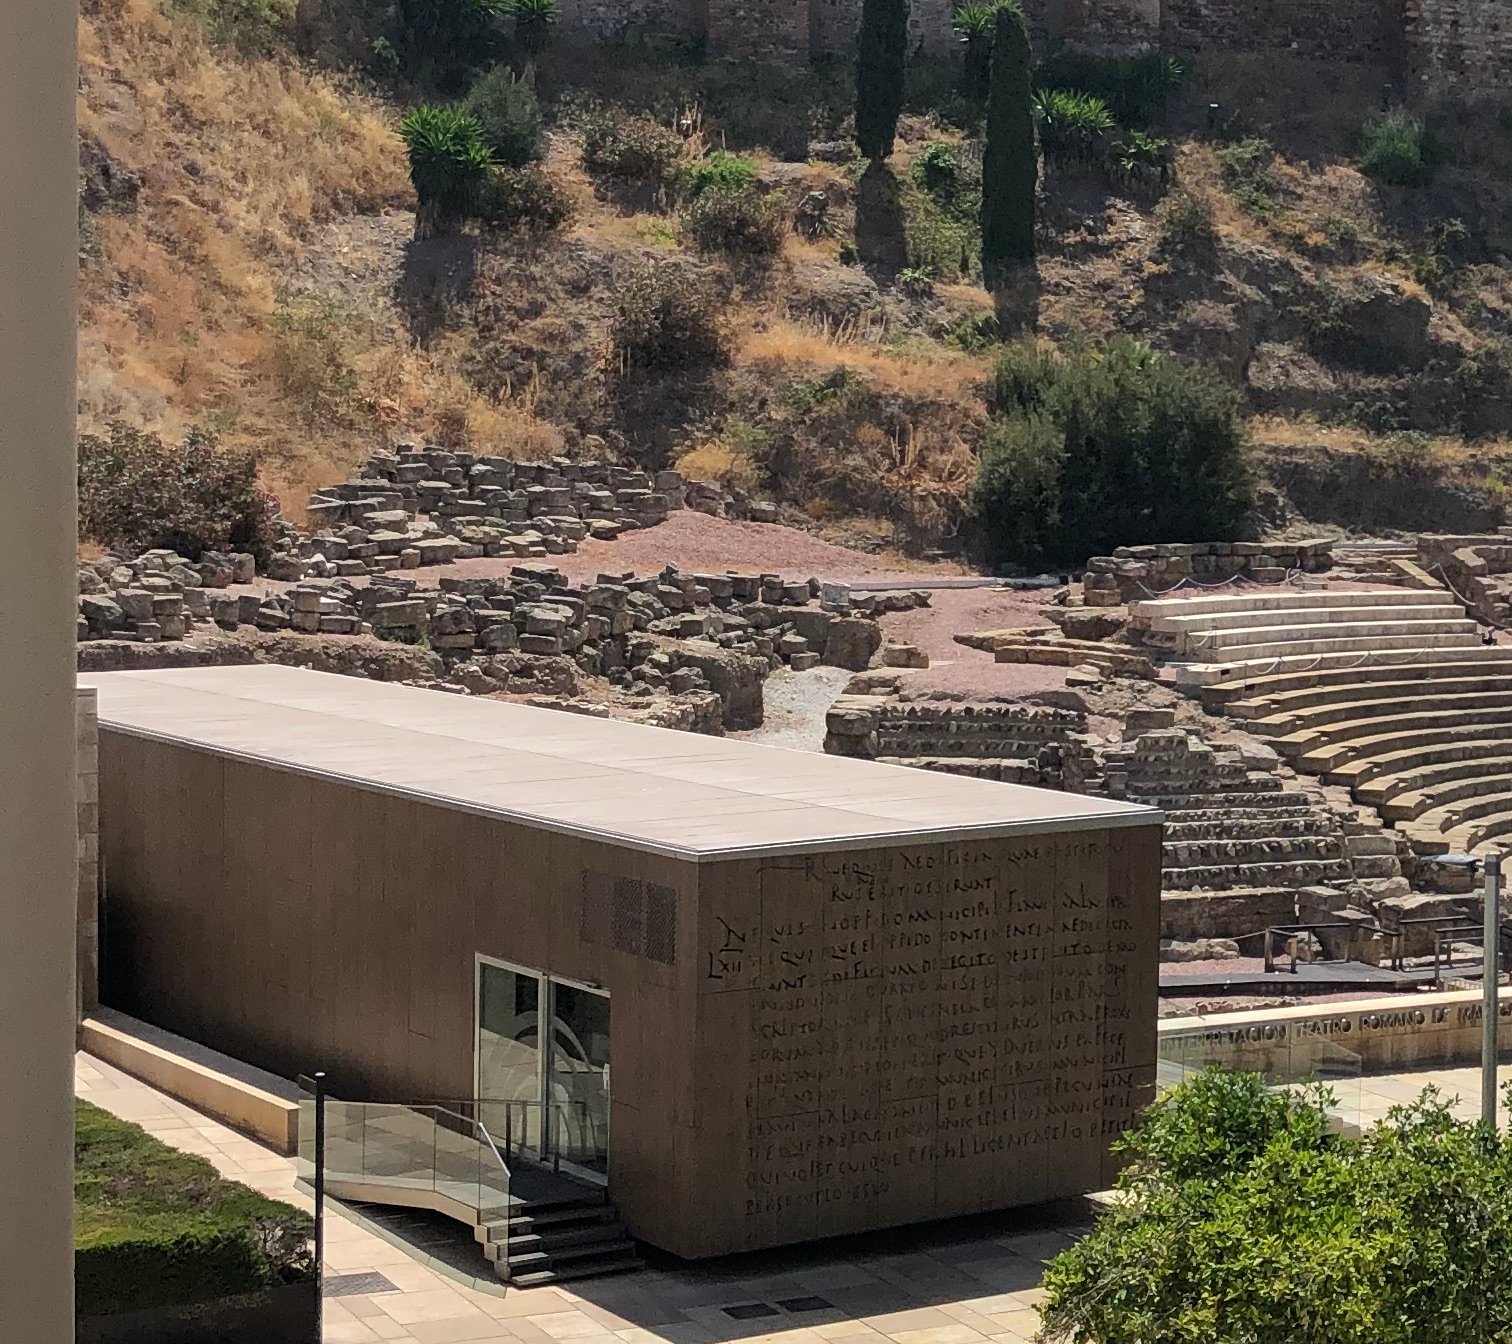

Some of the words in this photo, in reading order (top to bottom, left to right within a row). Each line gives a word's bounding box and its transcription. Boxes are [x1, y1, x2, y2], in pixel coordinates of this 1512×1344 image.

[1295, 1016, 1352, 1037] TEATRO
[1359, 1009, 1425, 1031] ROMANO
[1432, 1006, 1450, 1024] DE
